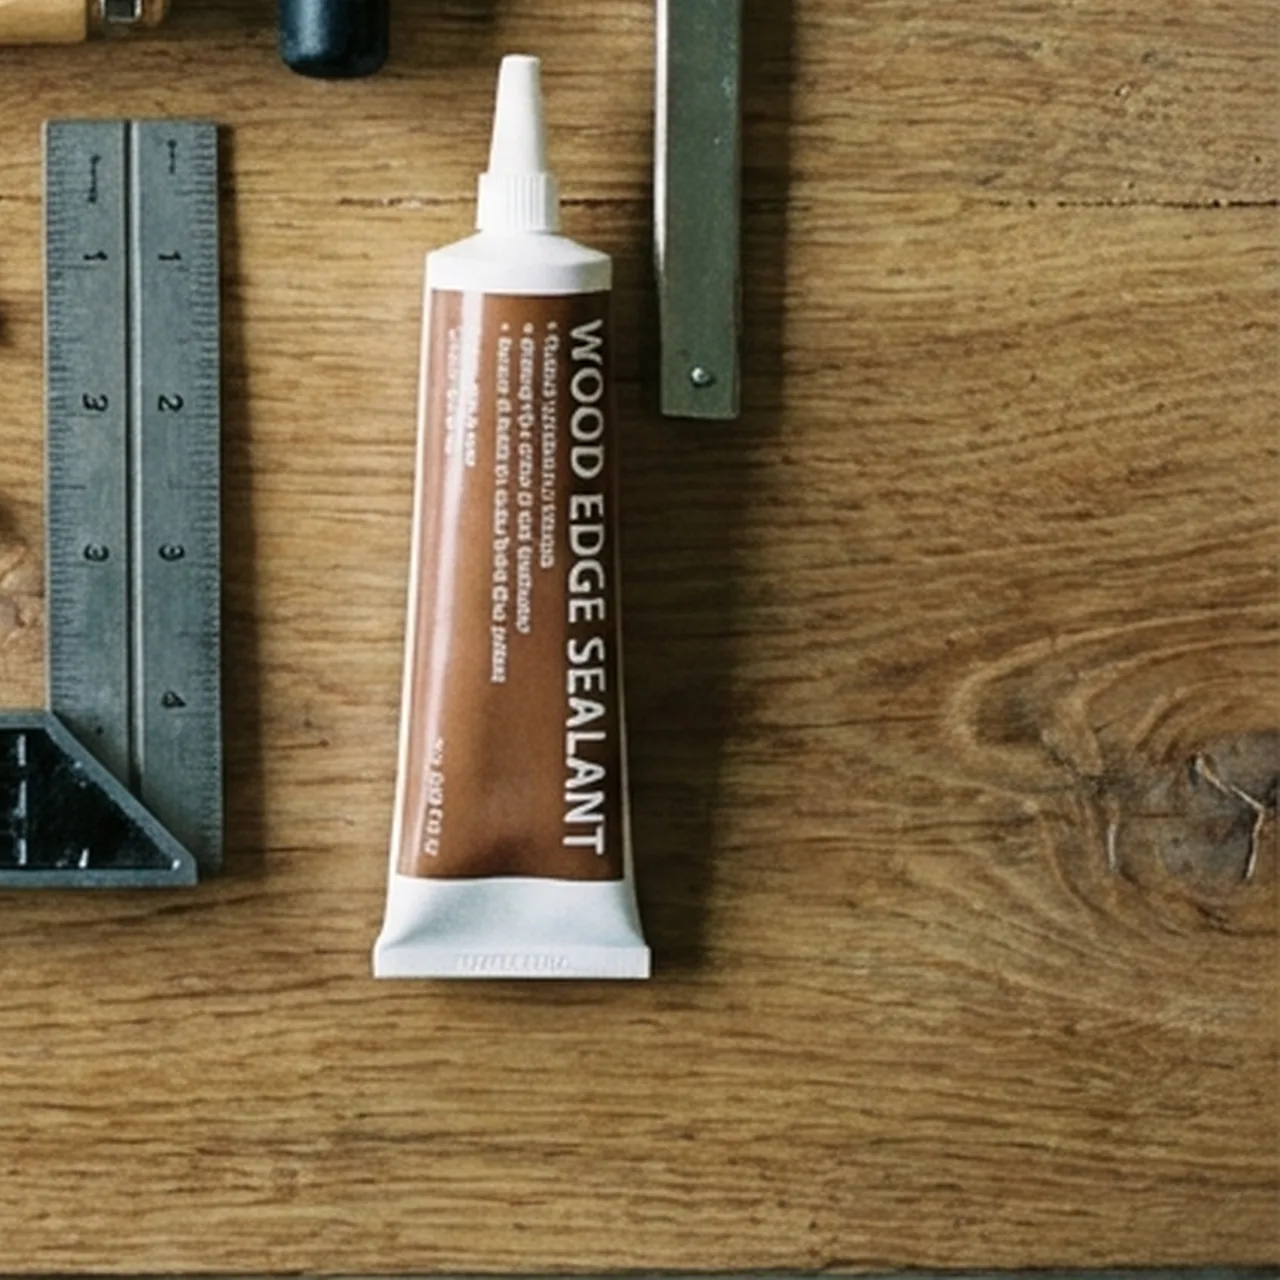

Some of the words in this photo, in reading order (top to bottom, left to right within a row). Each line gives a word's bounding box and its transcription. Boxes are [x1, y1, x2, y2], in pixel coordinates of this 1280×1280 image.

[157, 393, 185, 413] 2
[569, 318, 604, 479] WOOD
[567, 494, 605, 624] EDGE
[562, 637, 606, 855] SEALANT
